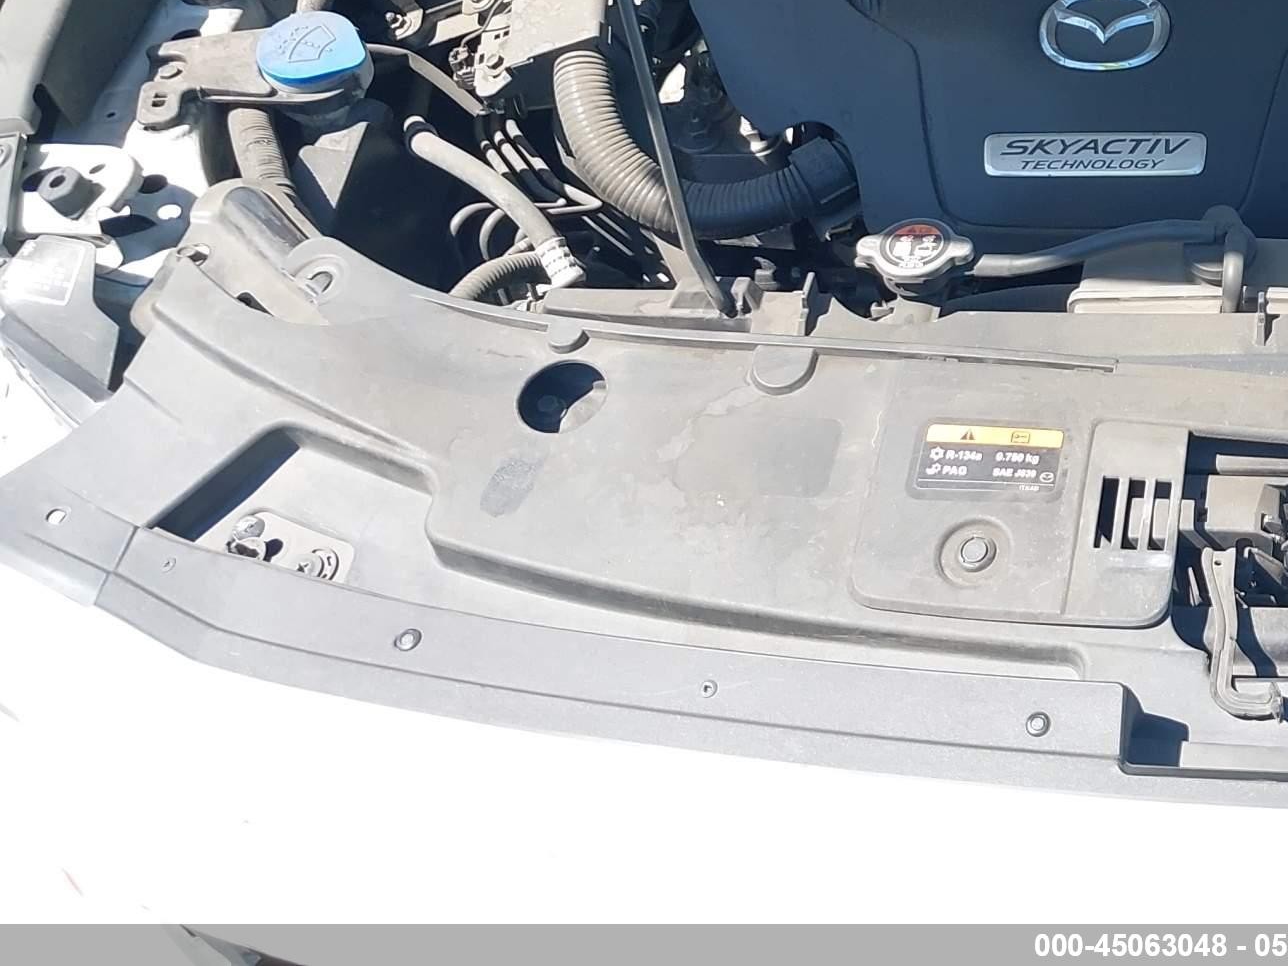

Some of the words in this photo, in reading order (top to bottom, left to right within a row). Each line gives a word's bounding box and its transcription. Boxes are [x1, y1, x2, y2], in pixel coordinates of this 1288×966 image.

[1000, 138, 1191, 155] SKYACTIV
[1020, 159, 1165, 170] TECHNOLOGY
[945, 449, 983, 461] R-134a
[1025, 453, 1040, 465] kg
[992, 467, 1014, 477] SAE
